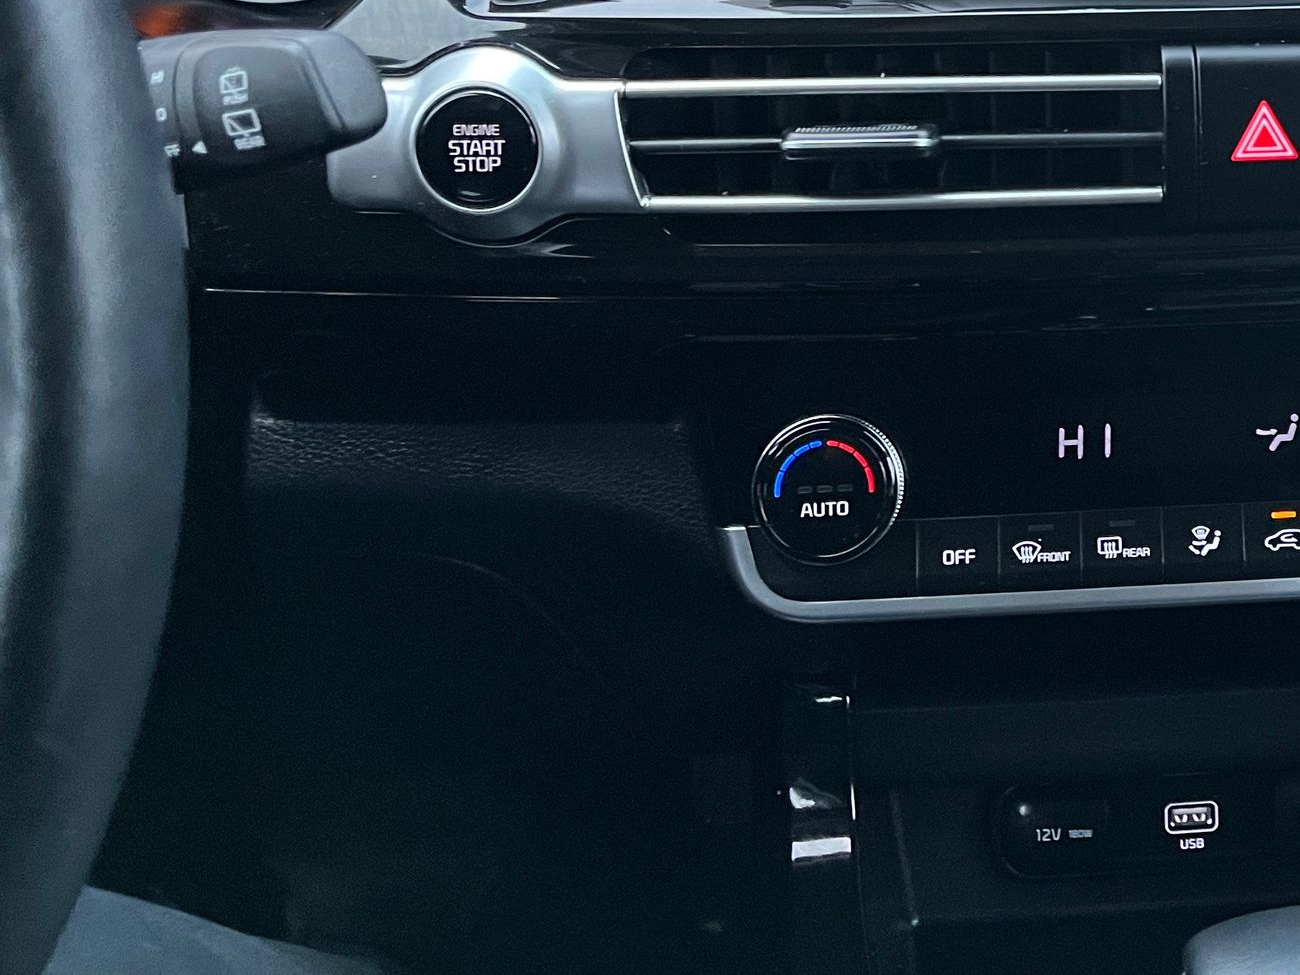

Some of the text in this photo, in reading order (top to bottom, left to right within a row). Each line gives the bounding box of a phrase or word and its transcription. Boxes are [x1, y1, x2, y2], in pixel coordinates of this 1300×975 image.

[453, 124, 499, 135] ENGINE
[449, 140, 505, 155] START
[454, 157, 501, 172] STOP
[801, 501, 848, 517] AUTO
[943, 549, 975, 565] OFF
[1037, 549, 1071, 563] FRONT
[1122, 546, 1150, 558] REAR
[1036, 828, 1061, 841] 12V
[1180, 838, 1204, 849] USB
